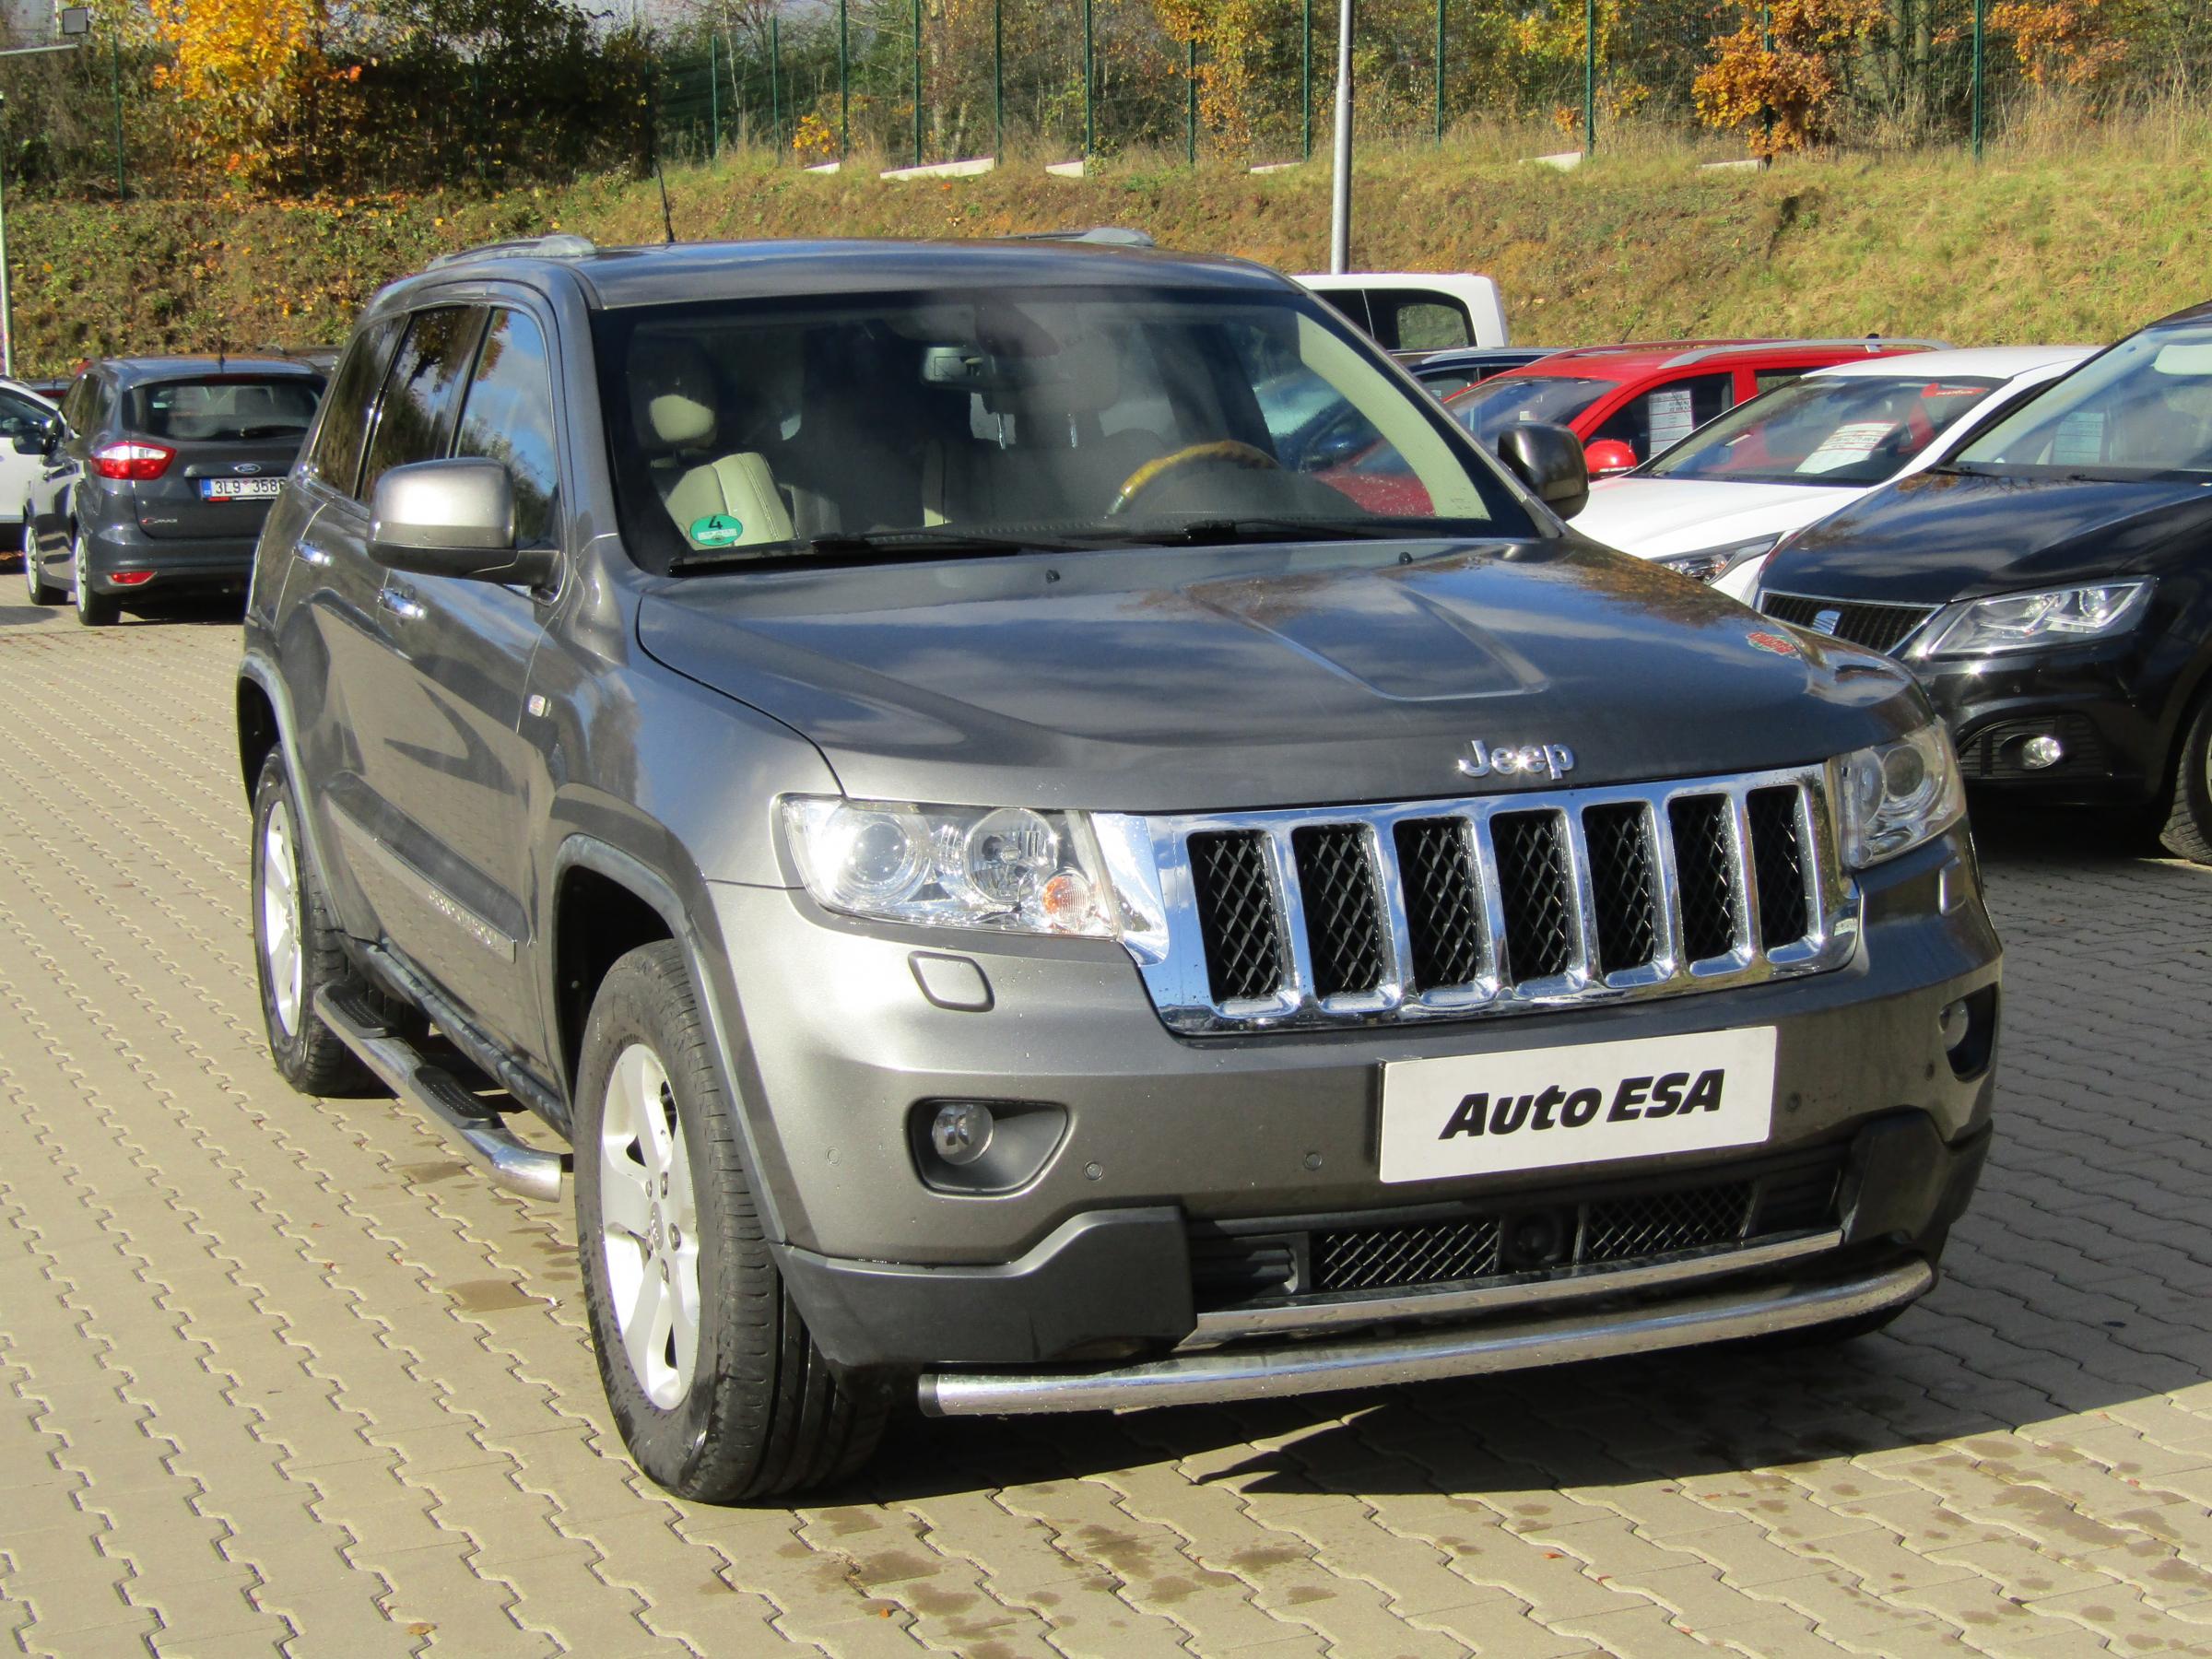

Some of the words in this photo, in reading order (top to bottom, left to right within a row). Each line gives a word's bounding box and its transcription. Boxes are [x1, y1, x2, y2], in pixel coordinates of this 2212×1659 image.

[215, 480, 241, 494] 3L9
[708, 515, 724, 529] 4
[1457, 740, 1575, 781] Jeep
[1438, 1085, 1602, 1140] Auto
[1606, 1068, 1725, 1123] ESA
